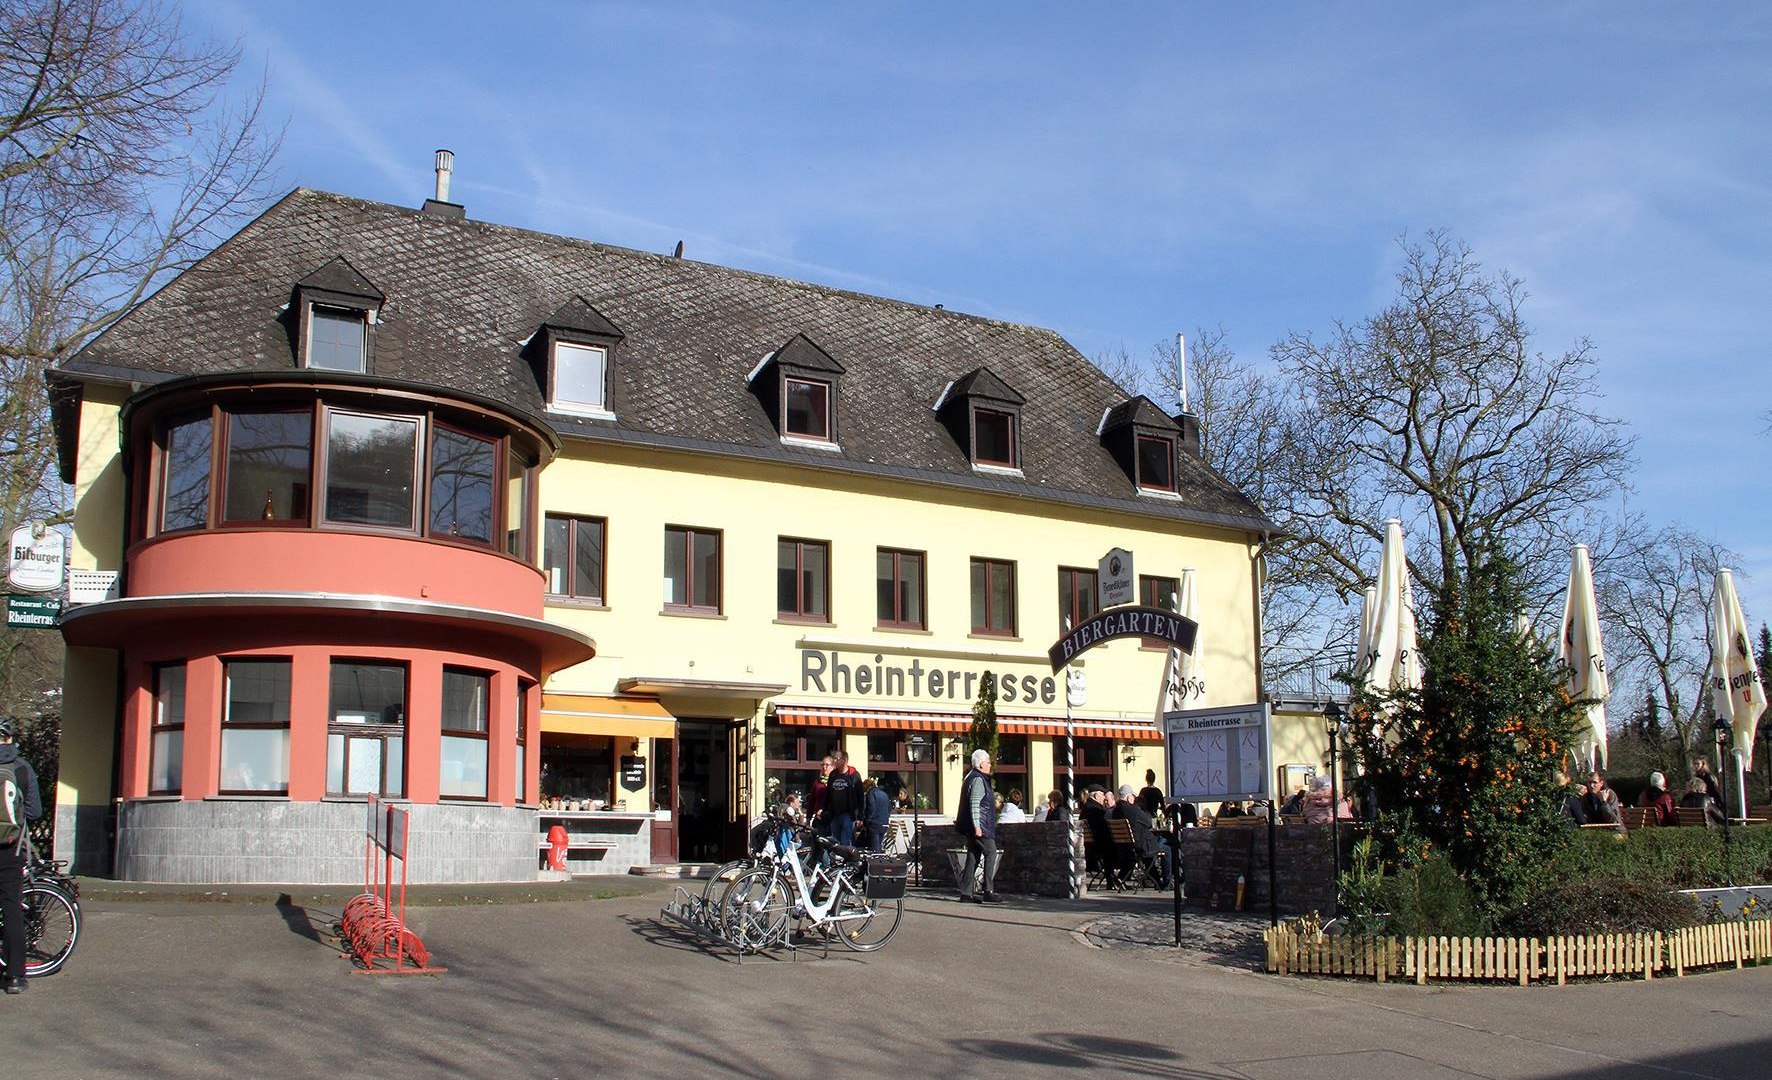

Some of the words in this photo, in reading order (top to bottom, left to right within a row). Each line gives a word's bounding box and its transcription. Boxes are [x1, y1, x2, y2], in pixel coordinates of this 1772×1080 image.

[14, 546, 60, 564] Bitburger
[10, 599, 42, 608] Restaurant
[1062, 612, 1180, 660] BIERGARTEN
[1188, 717, 1241, 729] Rheinterrasse
